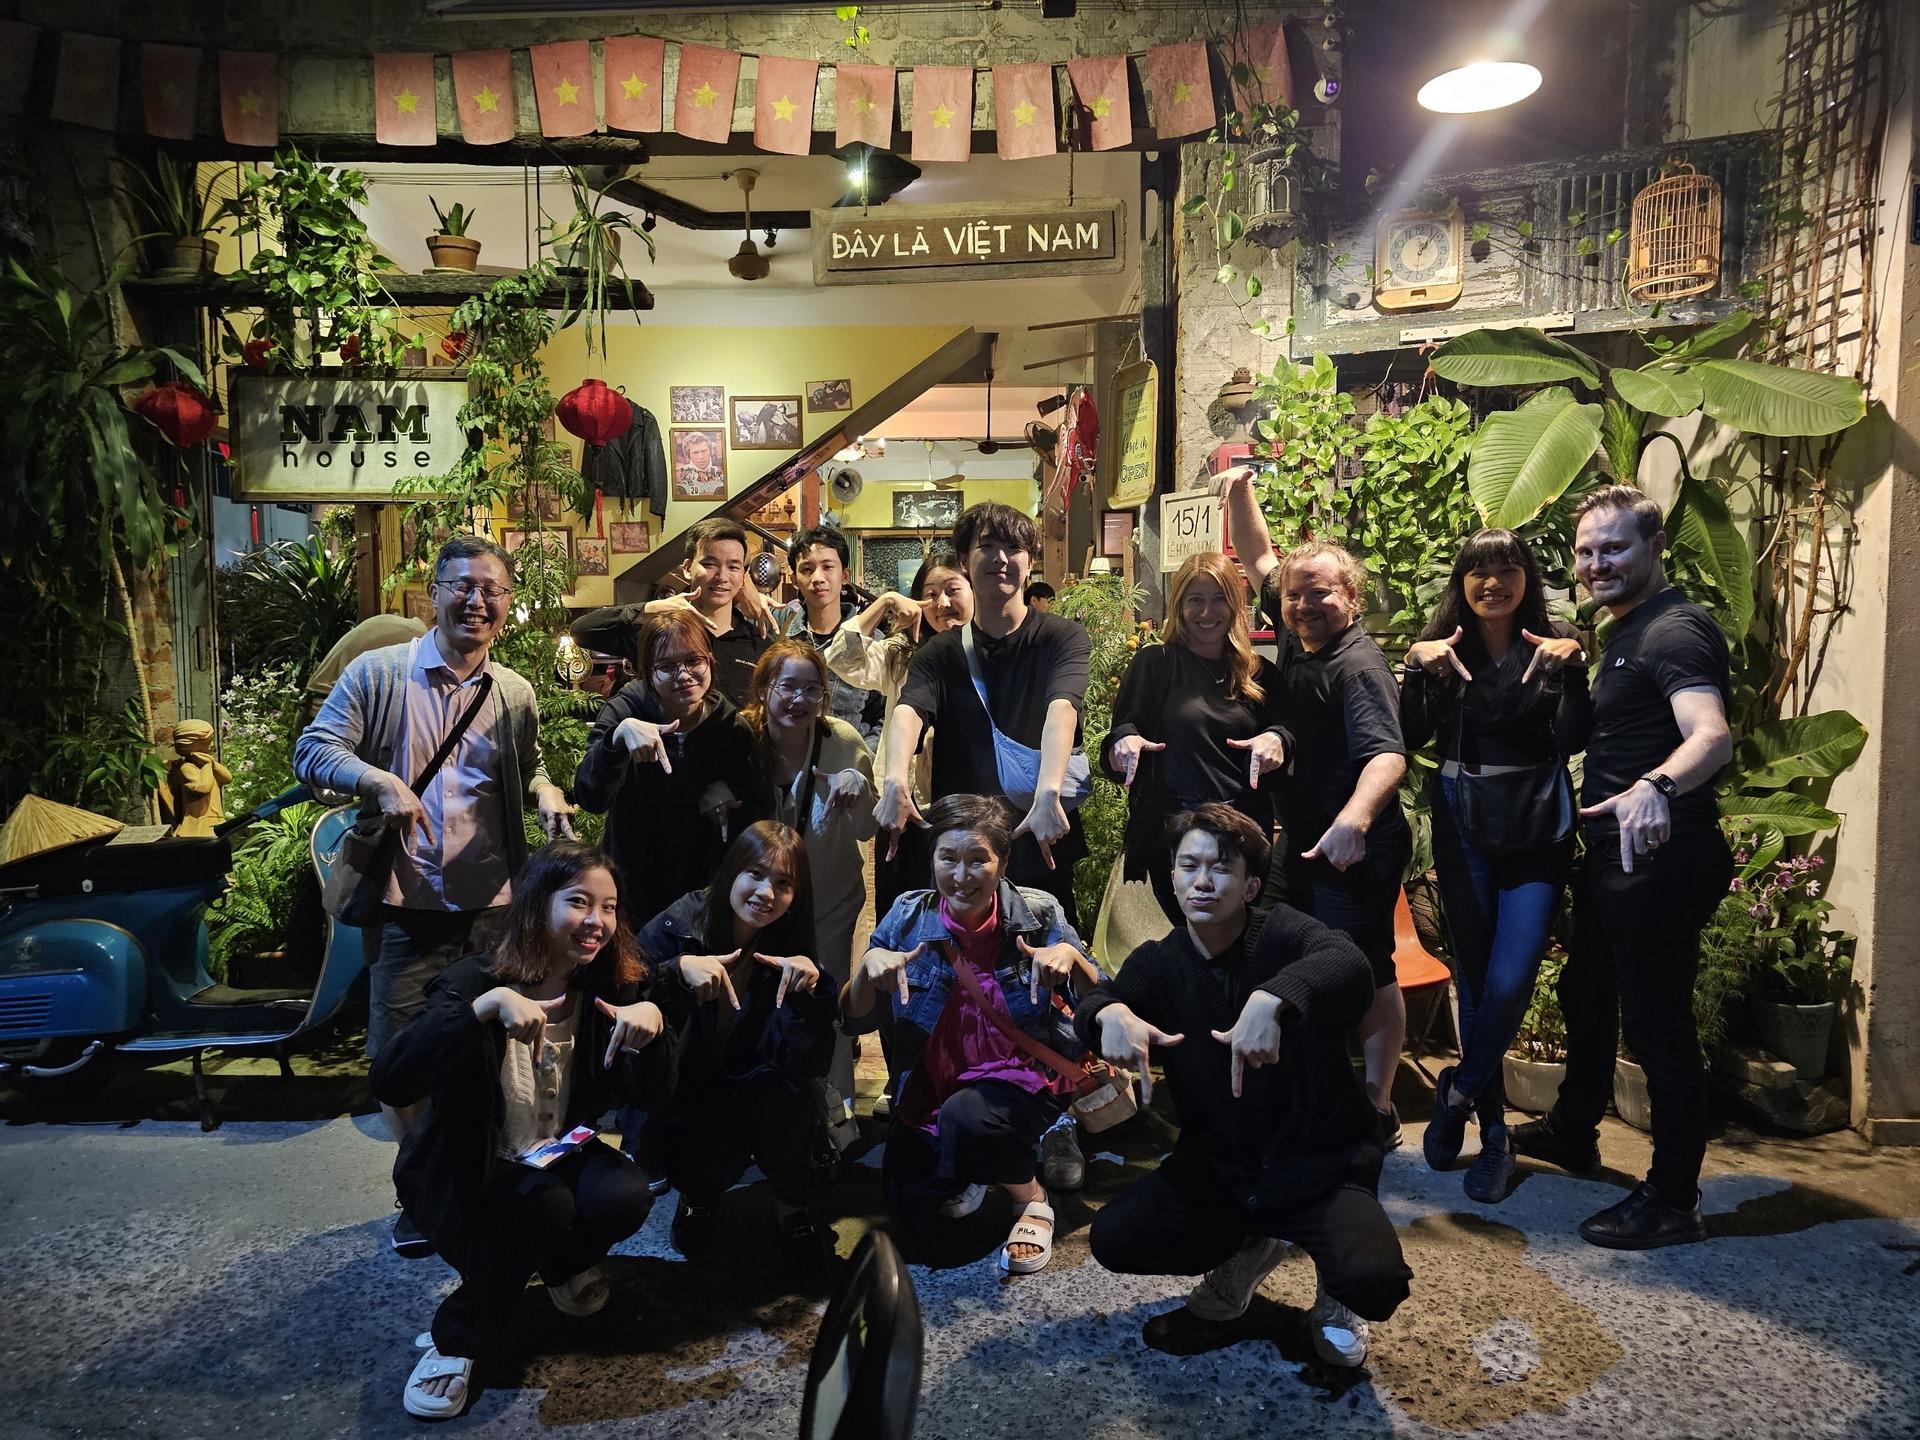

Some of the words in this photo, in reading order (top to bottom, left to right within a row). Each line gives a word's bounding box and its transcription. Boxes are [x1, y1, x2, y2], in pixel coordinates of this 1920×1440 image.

[832, 228, 885, 259] ĐÂY
[943, 219, 1012, 260] VIỆT
[1027, 222, 1099, 252] NAM
[279, 404, 431, 444] NAM
[282, 444, 431, 468] house
[1121, 462, 1150, 483] OPEN
[691, 487, 699, 495] 20
[1172, 504, 1211, 538] 15/1
[1017, 1227, 1036, 1235] FILA
